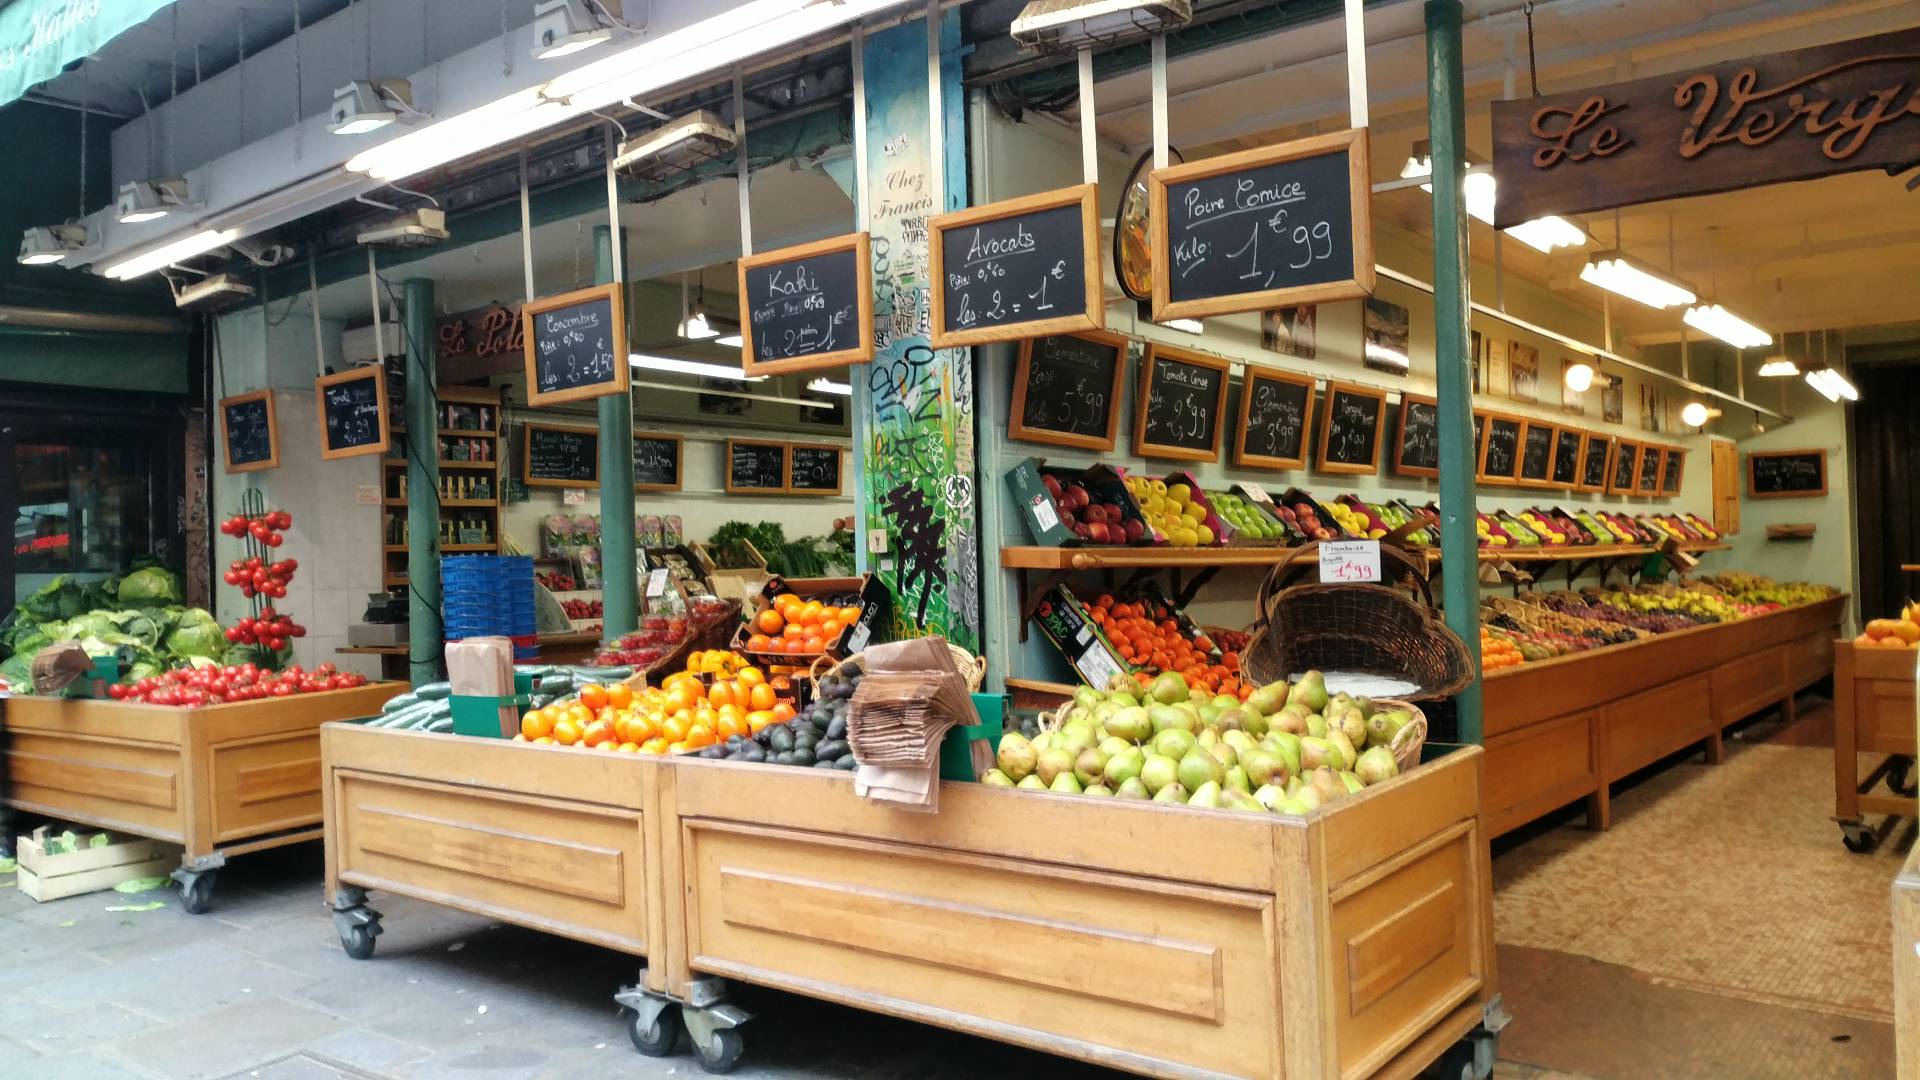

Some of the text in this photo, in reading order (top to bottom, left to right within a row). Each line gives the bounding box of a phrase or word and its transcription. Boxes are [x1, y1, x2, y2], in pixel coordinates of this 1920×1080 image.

[1530, 66, 1920, 168] Le Verg
[886, 169, 925, 192] Chez
[874, 193, 932, 220] Francis
[1184, 178, 1306, 220] Poire Comice
[966, 223, 1035, 262] Avocats
[769, 265, 819, 299] Kaki
